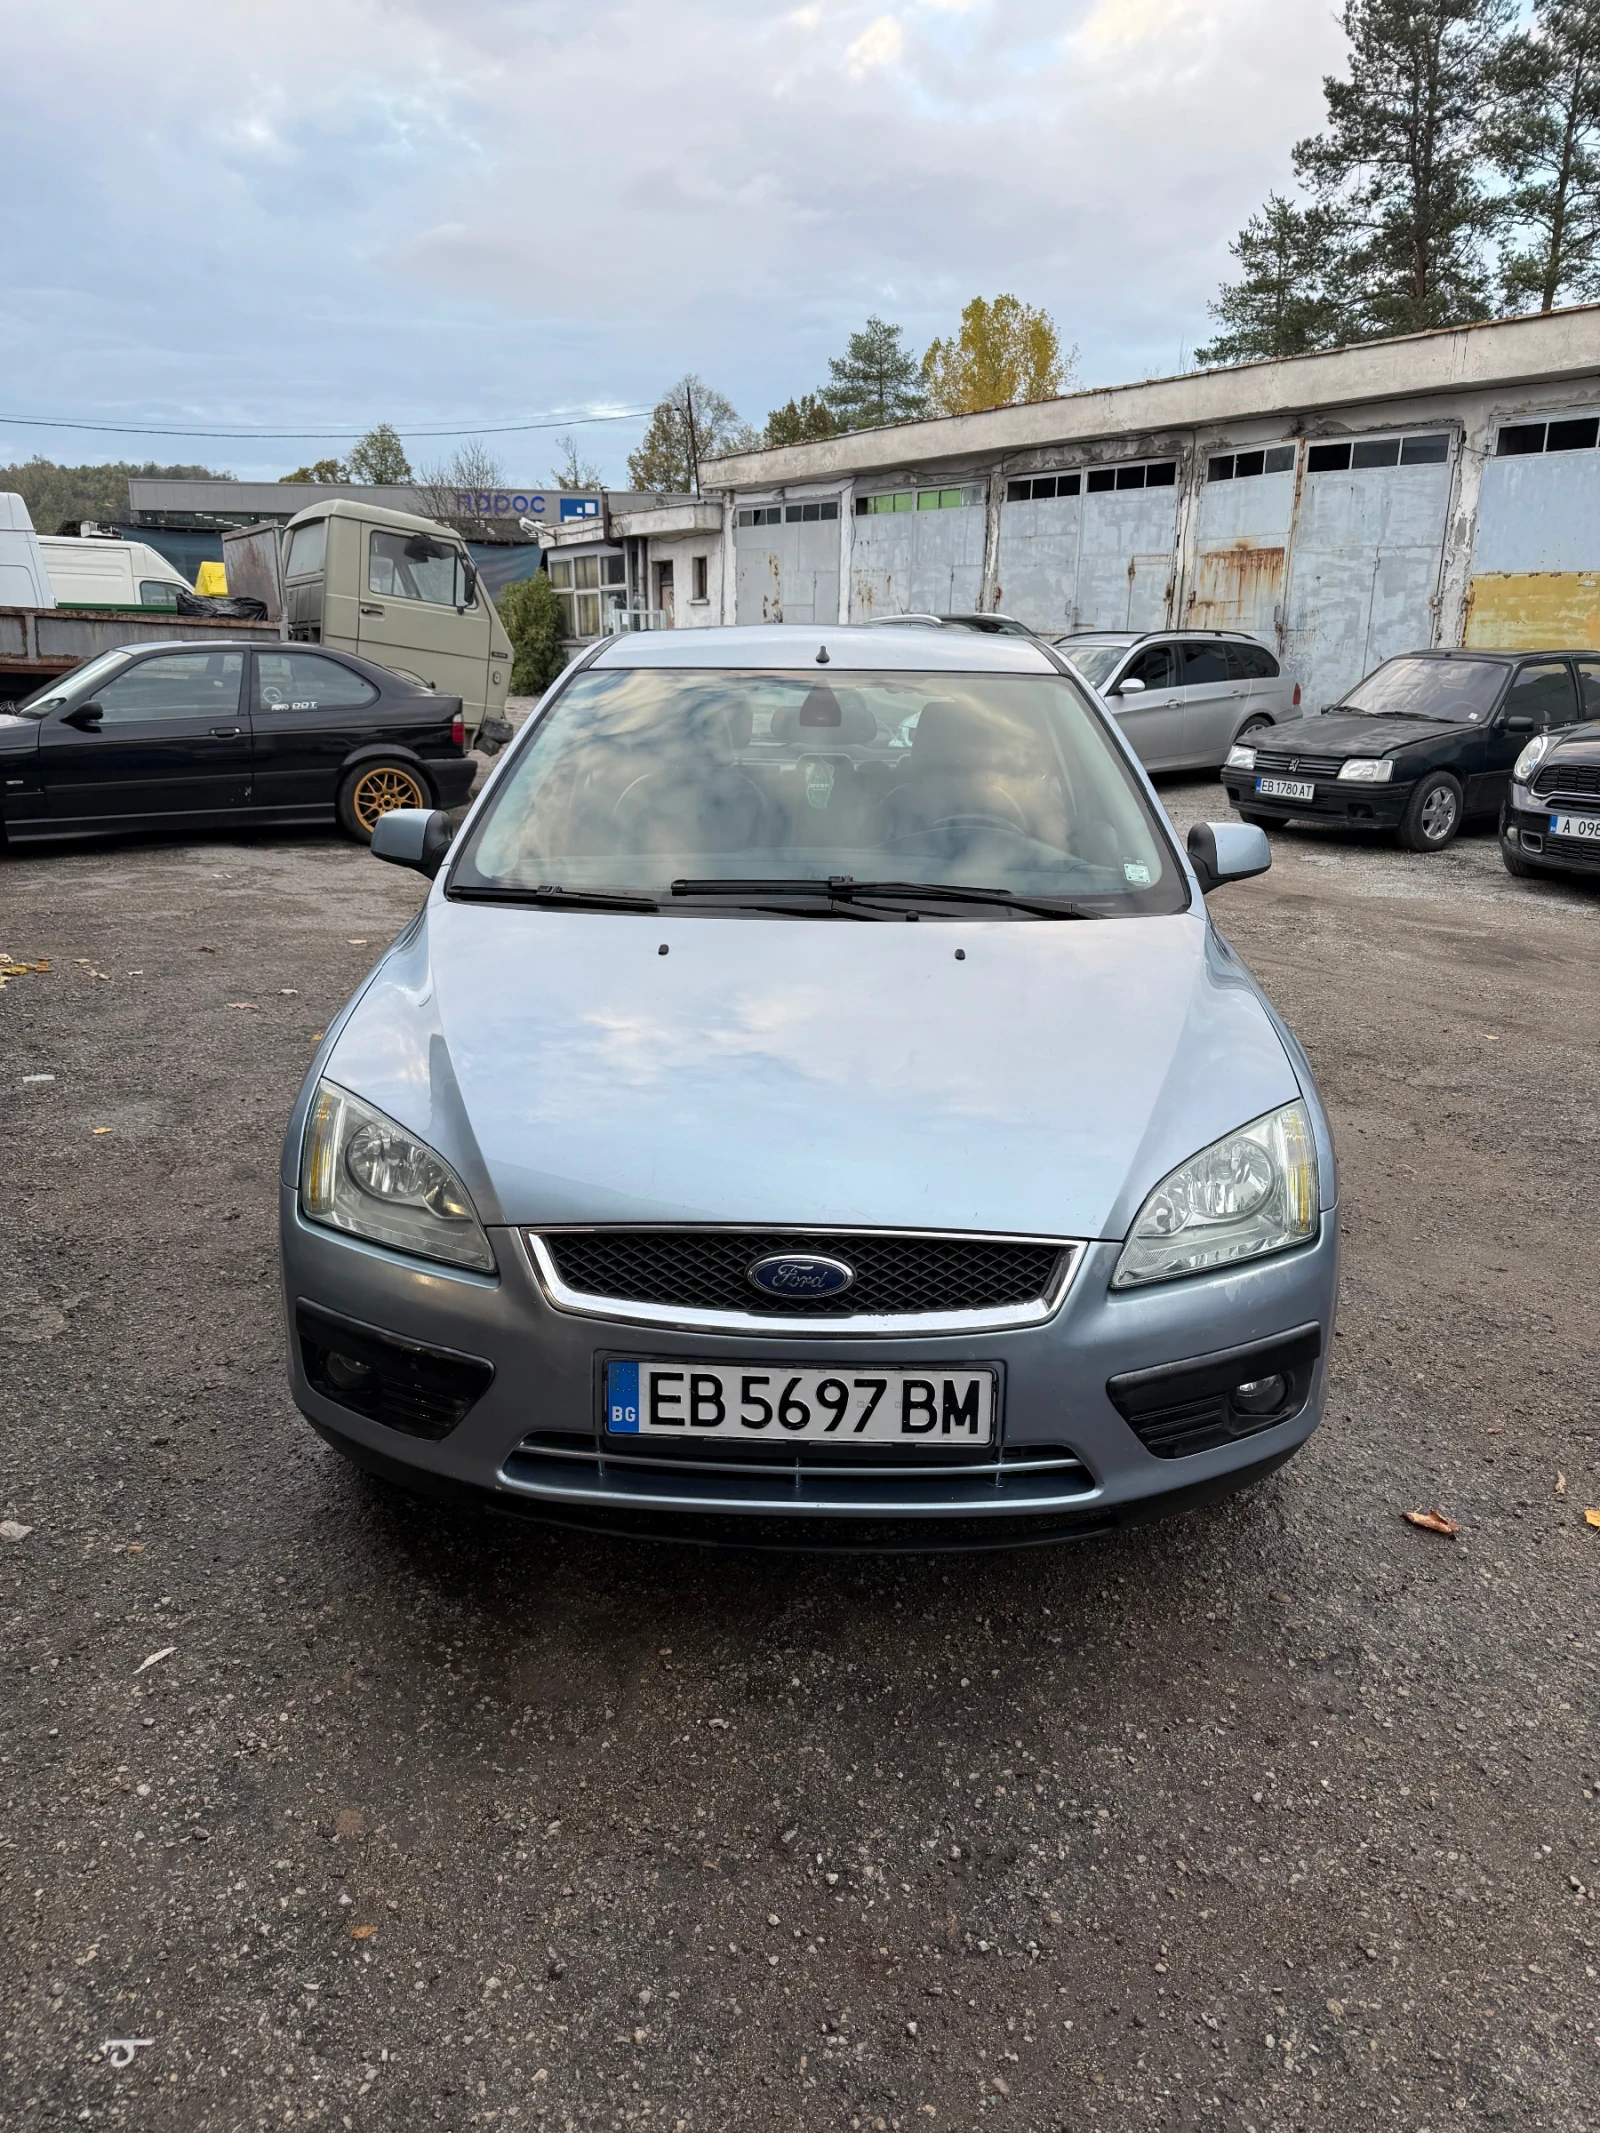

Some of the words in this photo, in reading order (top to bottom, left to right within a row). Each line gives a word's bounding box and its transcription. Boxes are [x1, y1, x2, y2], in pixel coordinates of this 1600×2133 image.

[1262, 781, 1274, 792] EB
[1277, 782, 1298, 795] 1780
[1299, 785, 1313, 797] AT
[1562, 819, 1570, 834] A
[771, 1264, 828, 1288] Ford
[650, 1371, 726, 1427] EB
[741, 1375, 888, 1433] 5697
[901, 1379, 980, 1434] BM
[611, 1406, 636, 1422] BG
